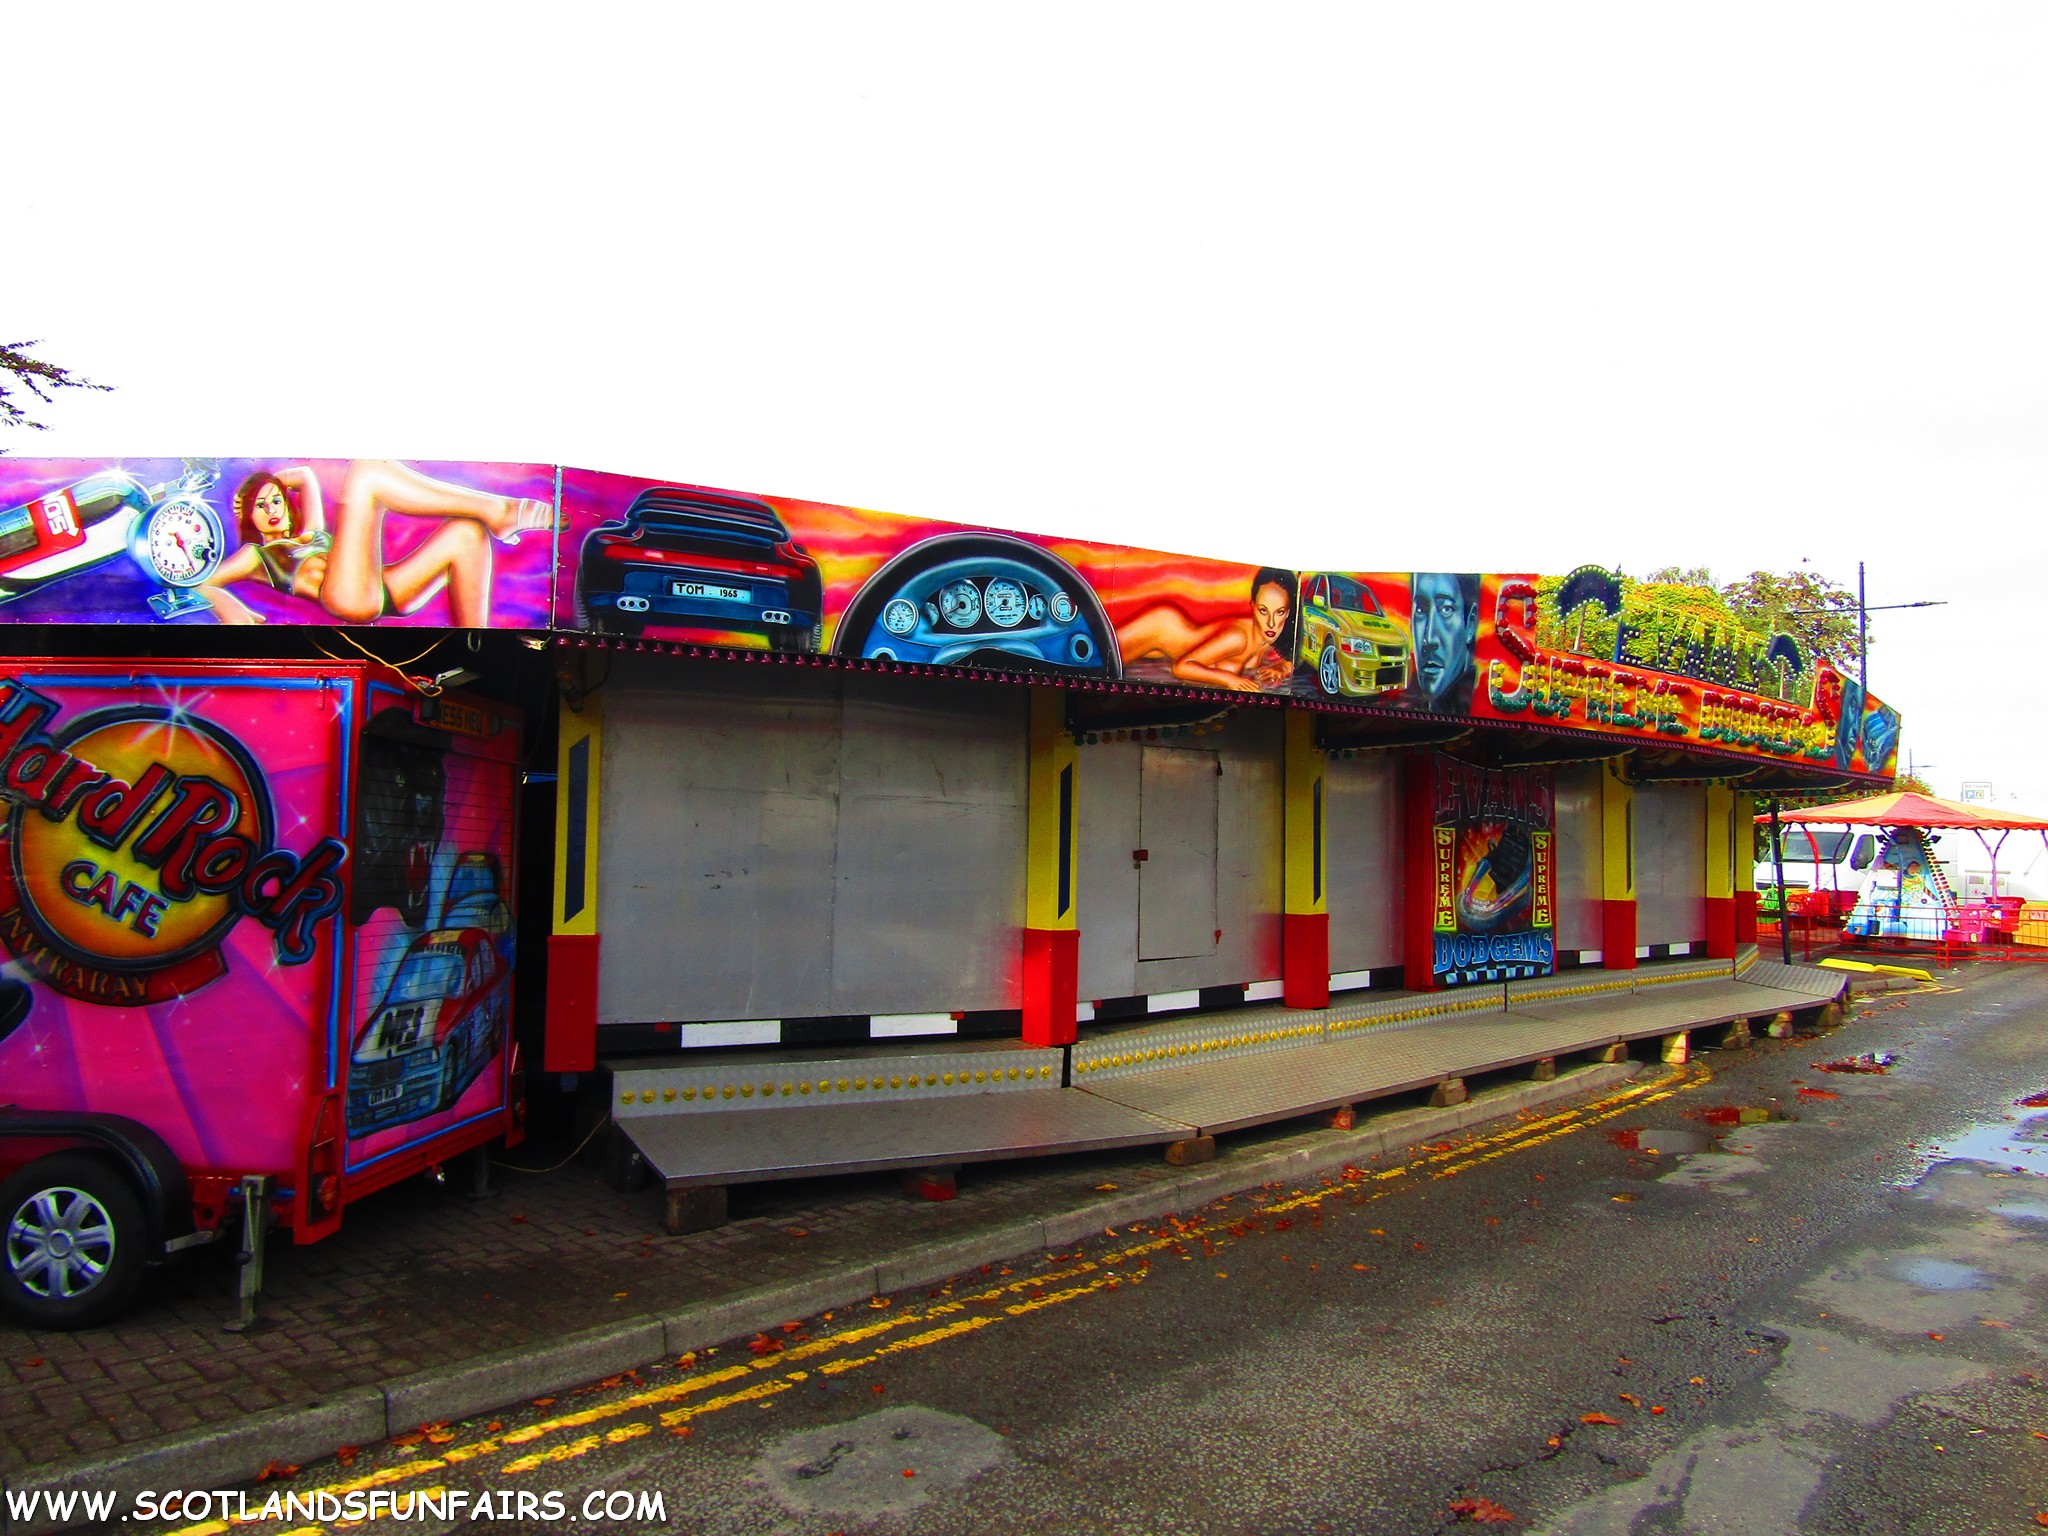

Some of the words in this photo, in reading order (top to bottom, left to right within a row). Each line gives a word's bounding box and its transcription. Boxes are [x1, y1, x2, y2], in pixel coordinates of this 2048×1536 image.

[676, 583, 704, 595] TOM
[1434, 751, 1550, 829] EVANS
[61, 860, 170, 939] CAFE
[132, 775, 348, 966] Rock
[1437, 830, 1454, 927] SUPREME
[1534, 835, 1549, 924] SUPREME
[3, 906, 149, 998] INVERARAY
[1433, 928, 1553, 974] DODGEMS
